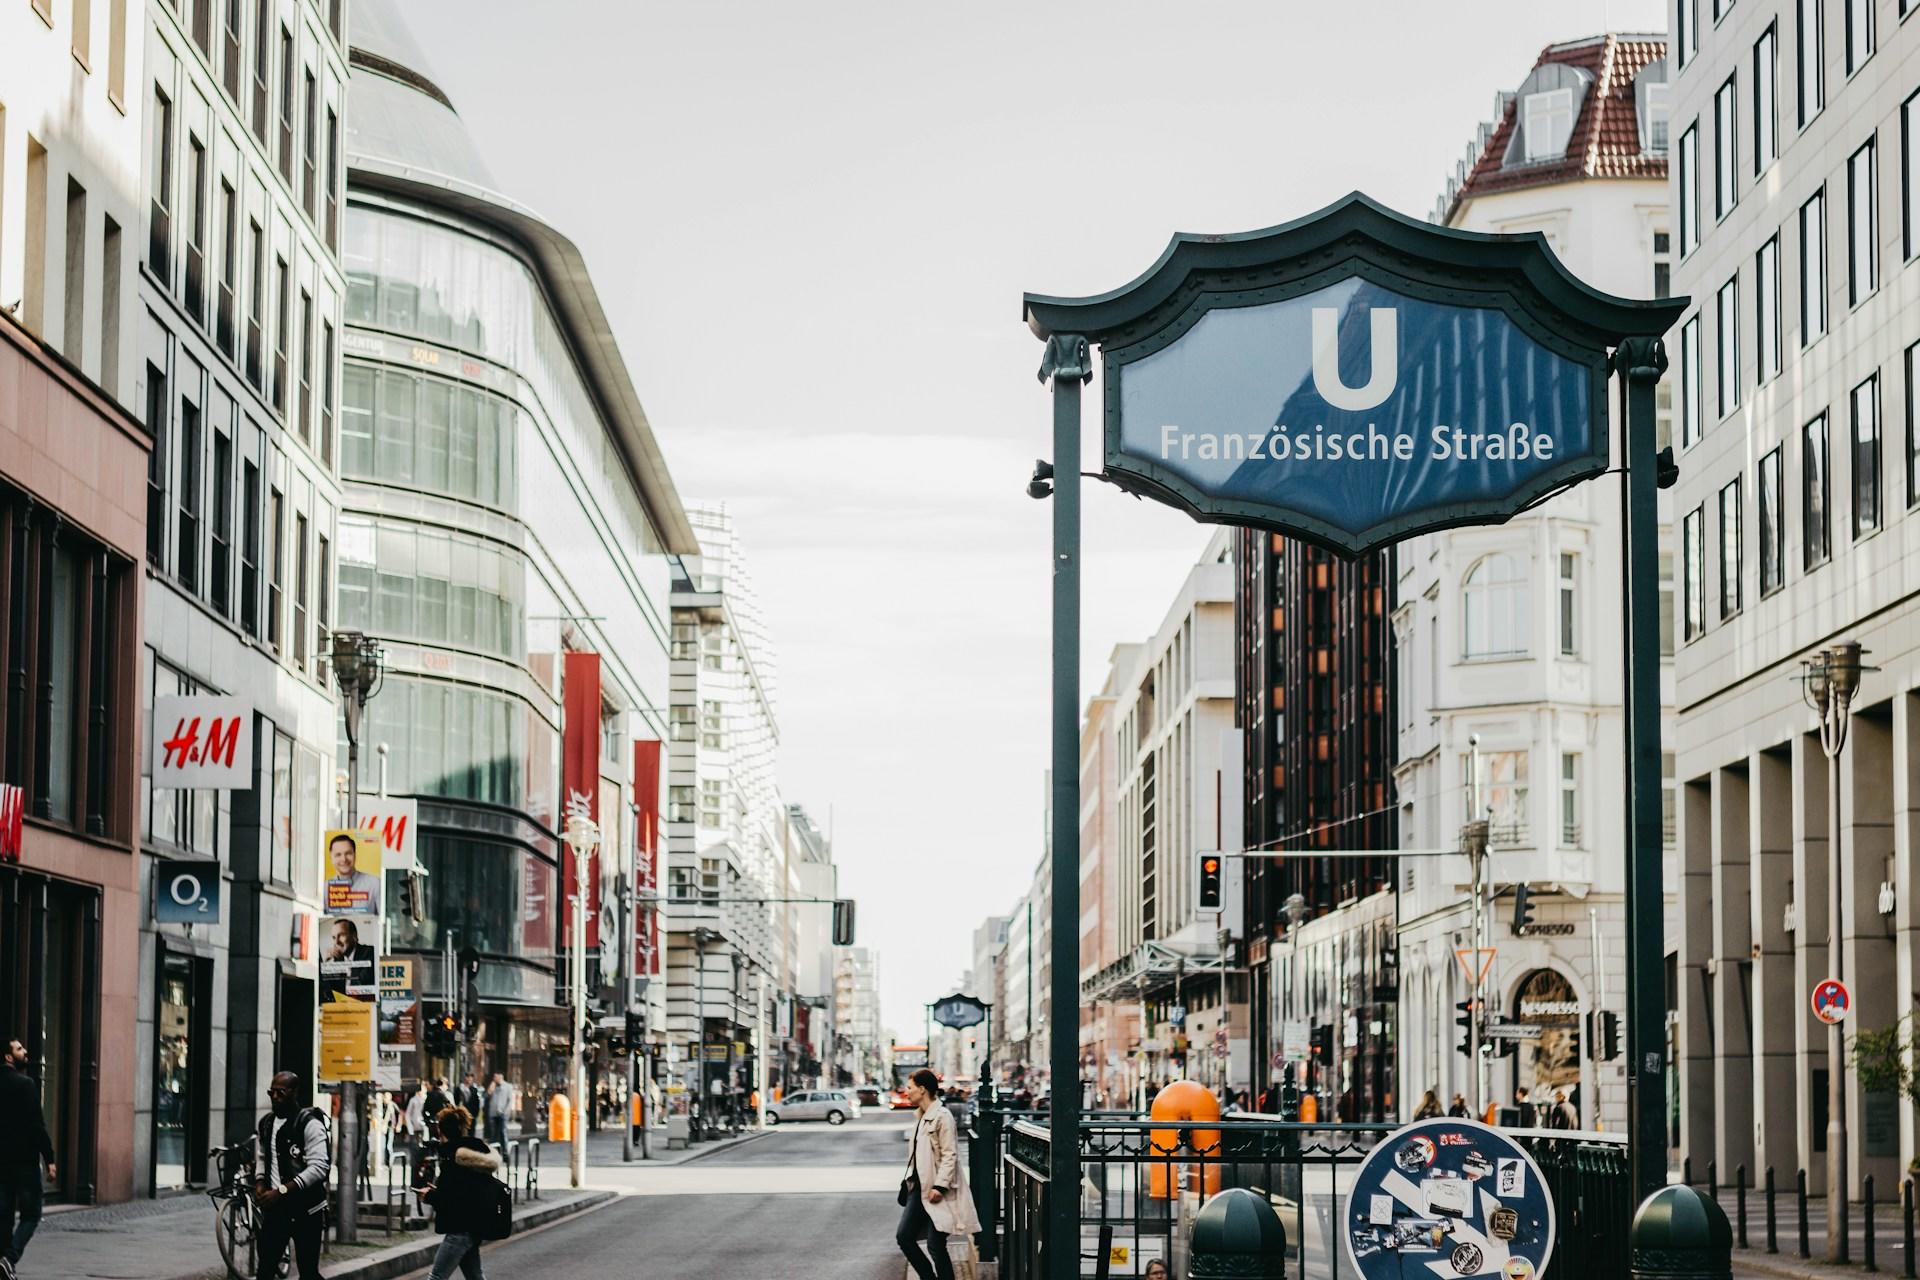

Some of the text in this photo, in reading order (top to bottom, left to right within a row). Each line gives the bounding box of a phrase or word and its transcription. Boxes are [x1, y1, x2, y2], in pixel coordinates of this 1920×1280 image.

[1312, 307, 1397, 411] U
[1161, 423, 1554, 461] Französische Straße
[163, 716, 241, 769] H&M
